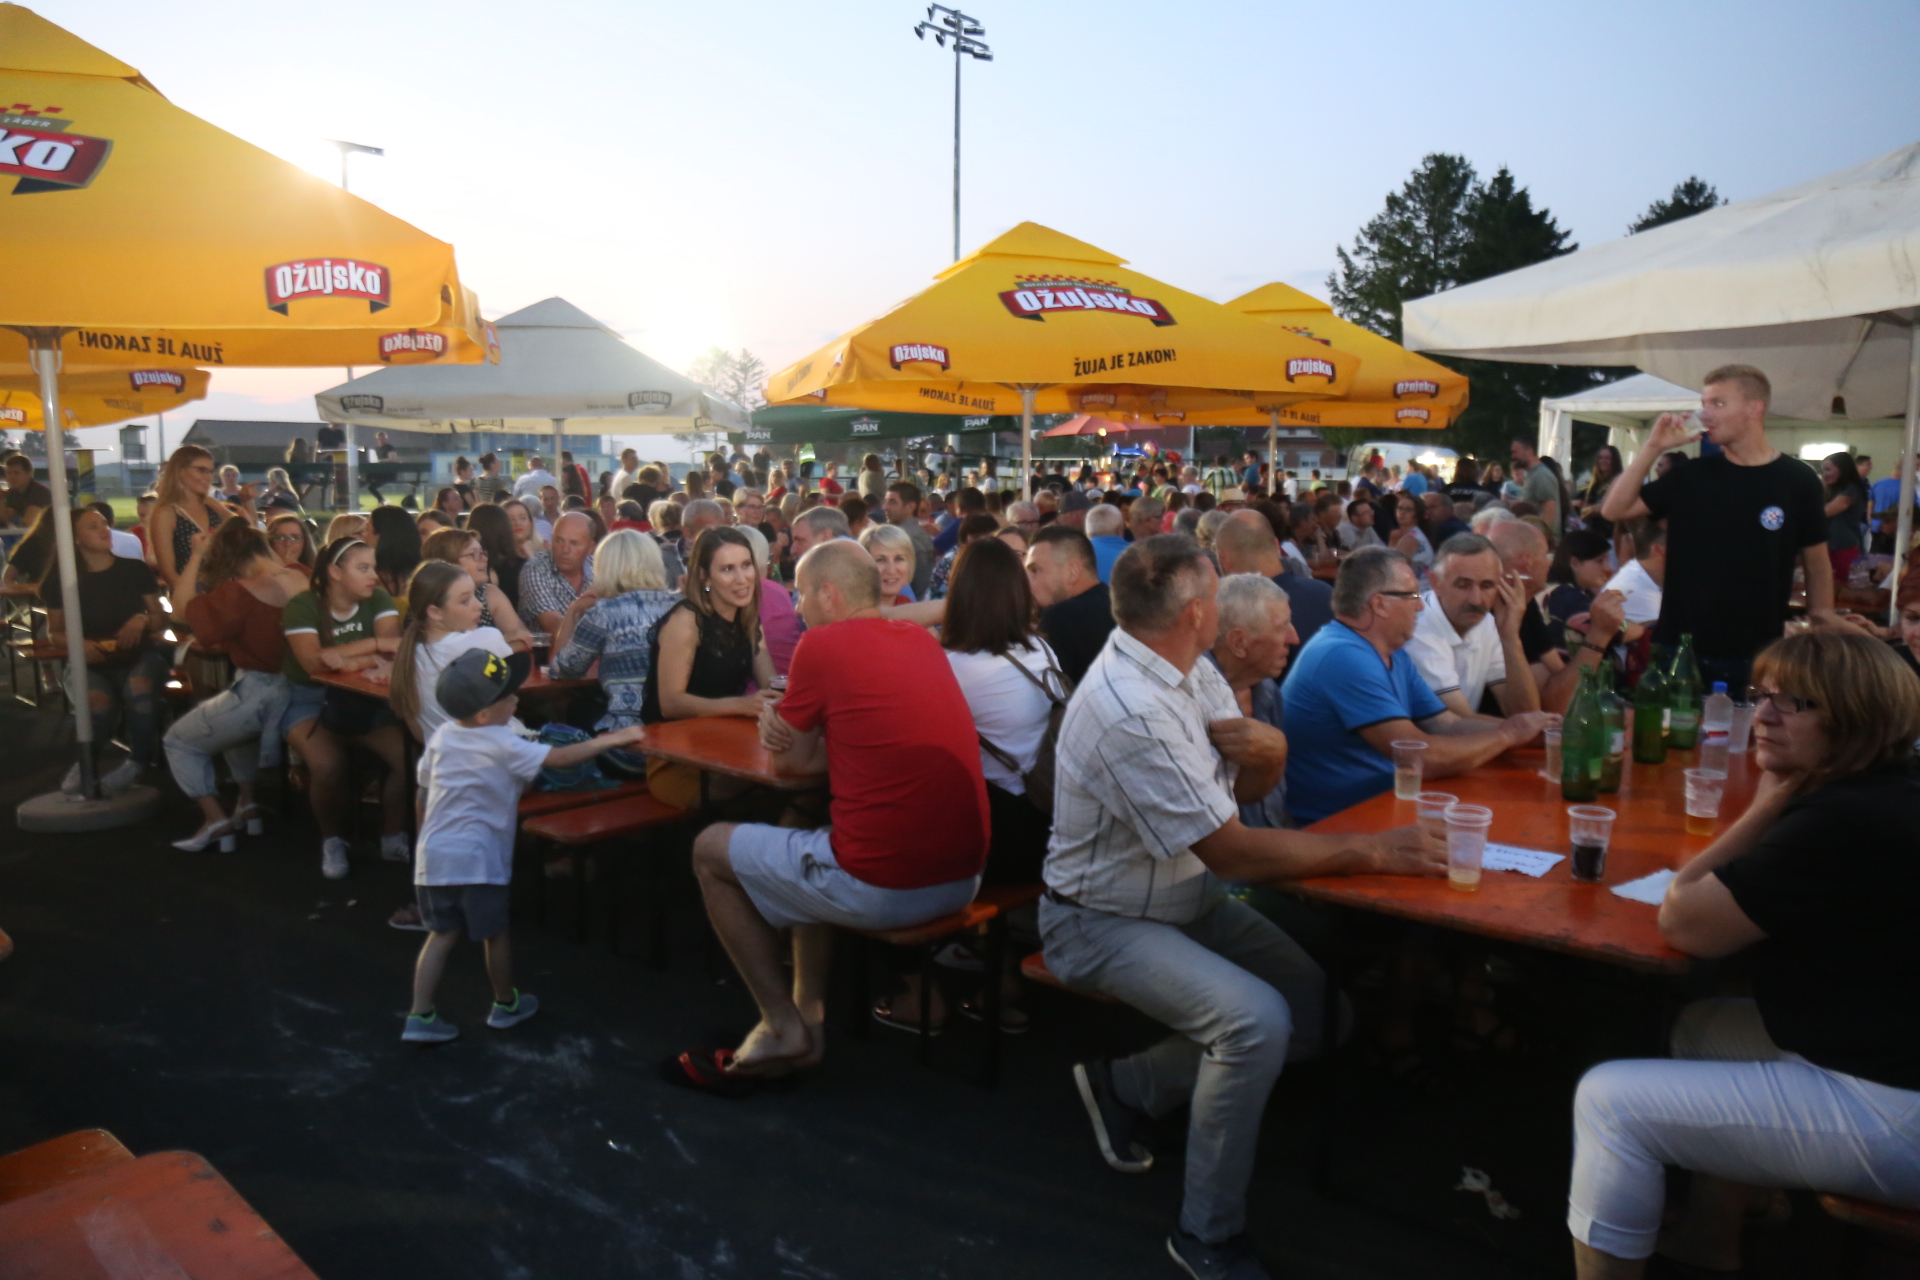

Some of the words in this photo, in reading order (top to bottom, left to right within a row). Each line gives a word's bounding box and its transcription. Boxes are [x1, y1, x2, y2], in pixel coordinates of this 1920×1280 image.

[276, 260, 381, 299] Ožujsko
[1014, 288, 1158, 316] Ožujsko
[894, 343, 945, 363] Ožujsko
[1074, 357, 1108, 377] ŽUJA
[1110, 353, 1125, 371] JE
[1128, 348, 1177, 367] ZAKON!
[1289, 358, 1333, 376] Ožujsko
[134, 371, 182, 386] Ožujsko
[853, 423, 879, 432] PAN
[964, 417, 990, 428] PAN
[746, 431, 771, 440] PAN
